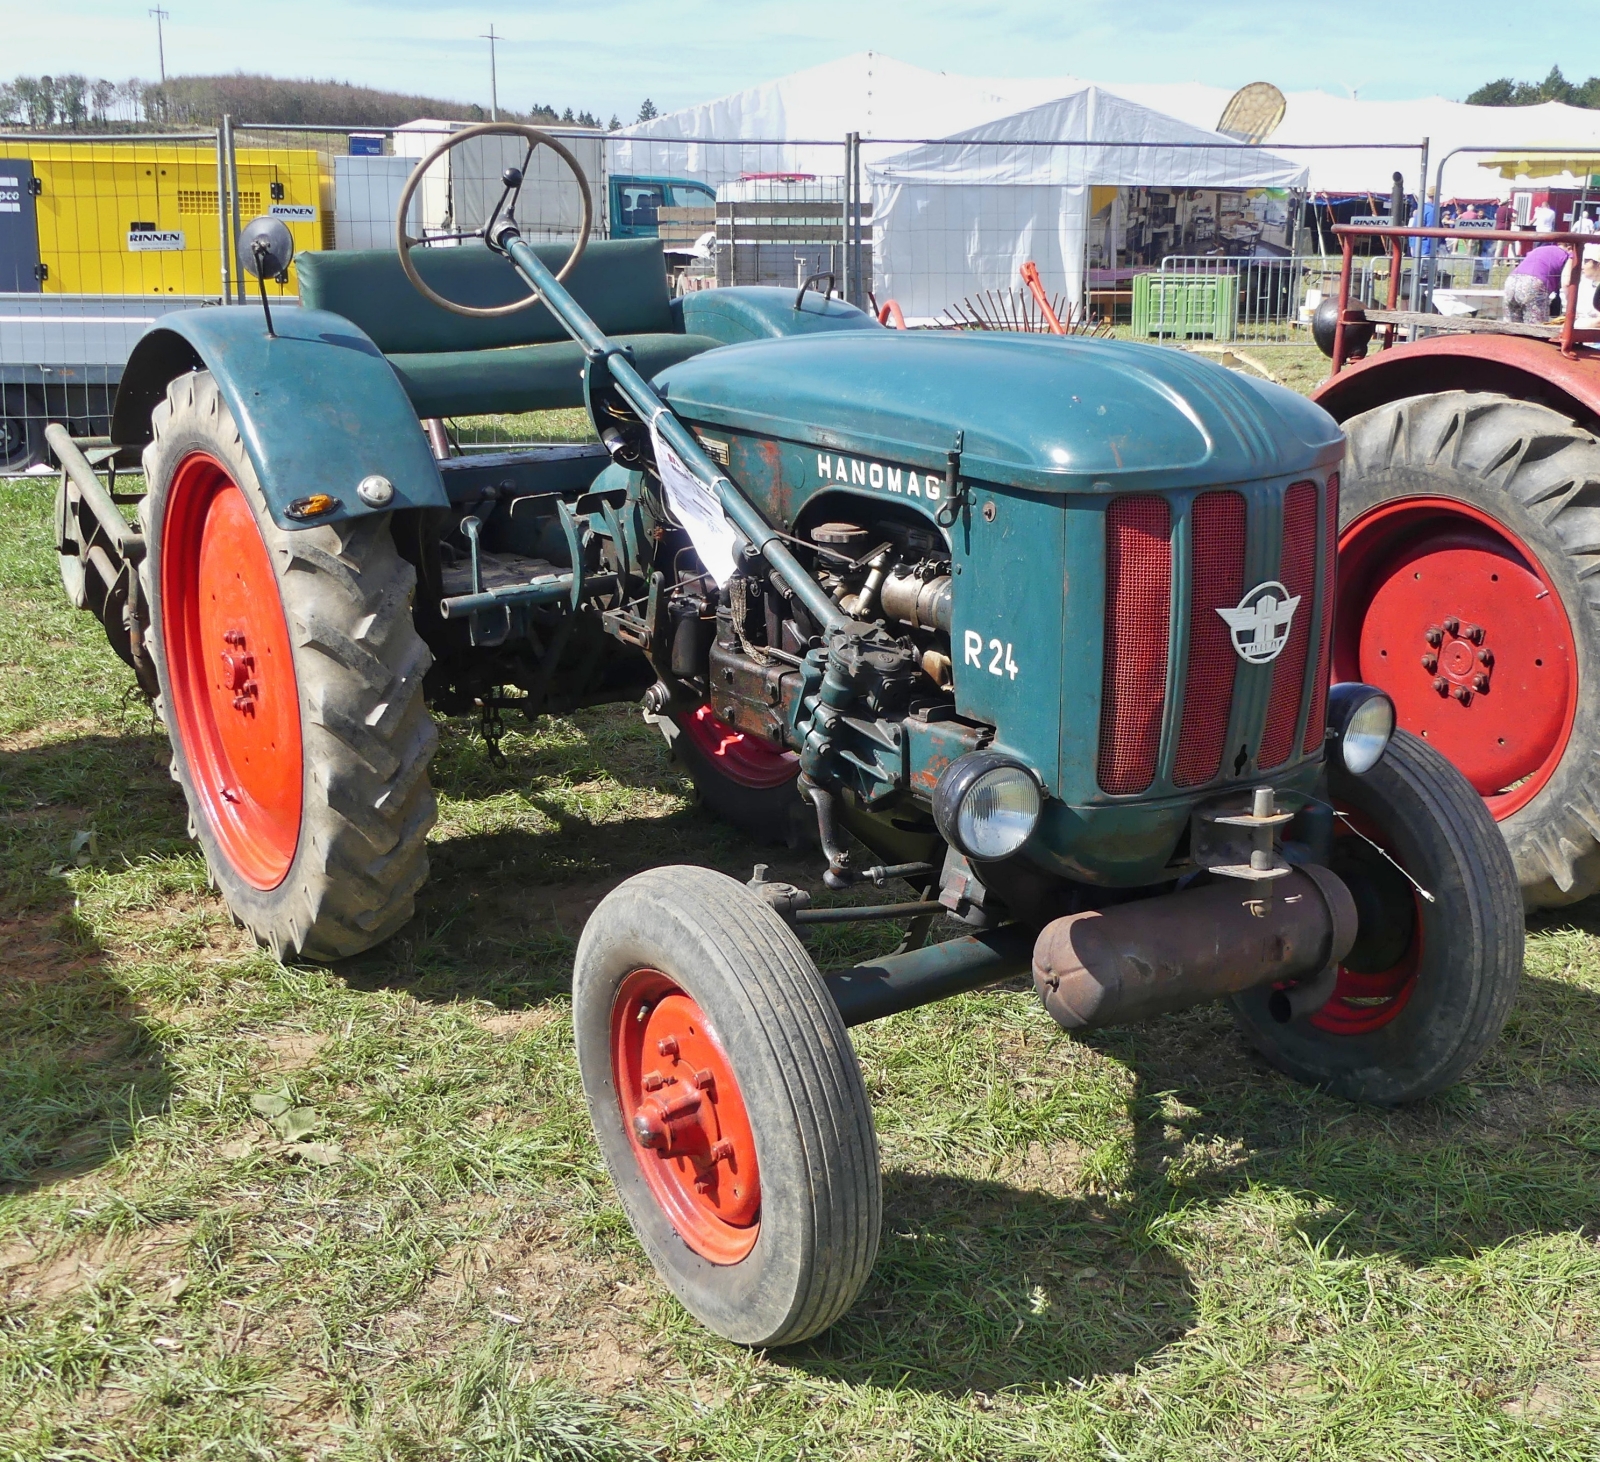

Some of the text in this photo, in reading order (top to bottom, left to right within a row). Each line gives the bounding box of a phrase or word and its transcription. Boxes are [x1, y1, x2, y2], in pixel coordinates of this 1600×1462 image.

[272, 207, 314, 215] RINNEN
[129, 233, 180, 242] RINNEN
[817, 453, 941, 500] HANOMAG
[964, 629, 1019, 681] R 24
